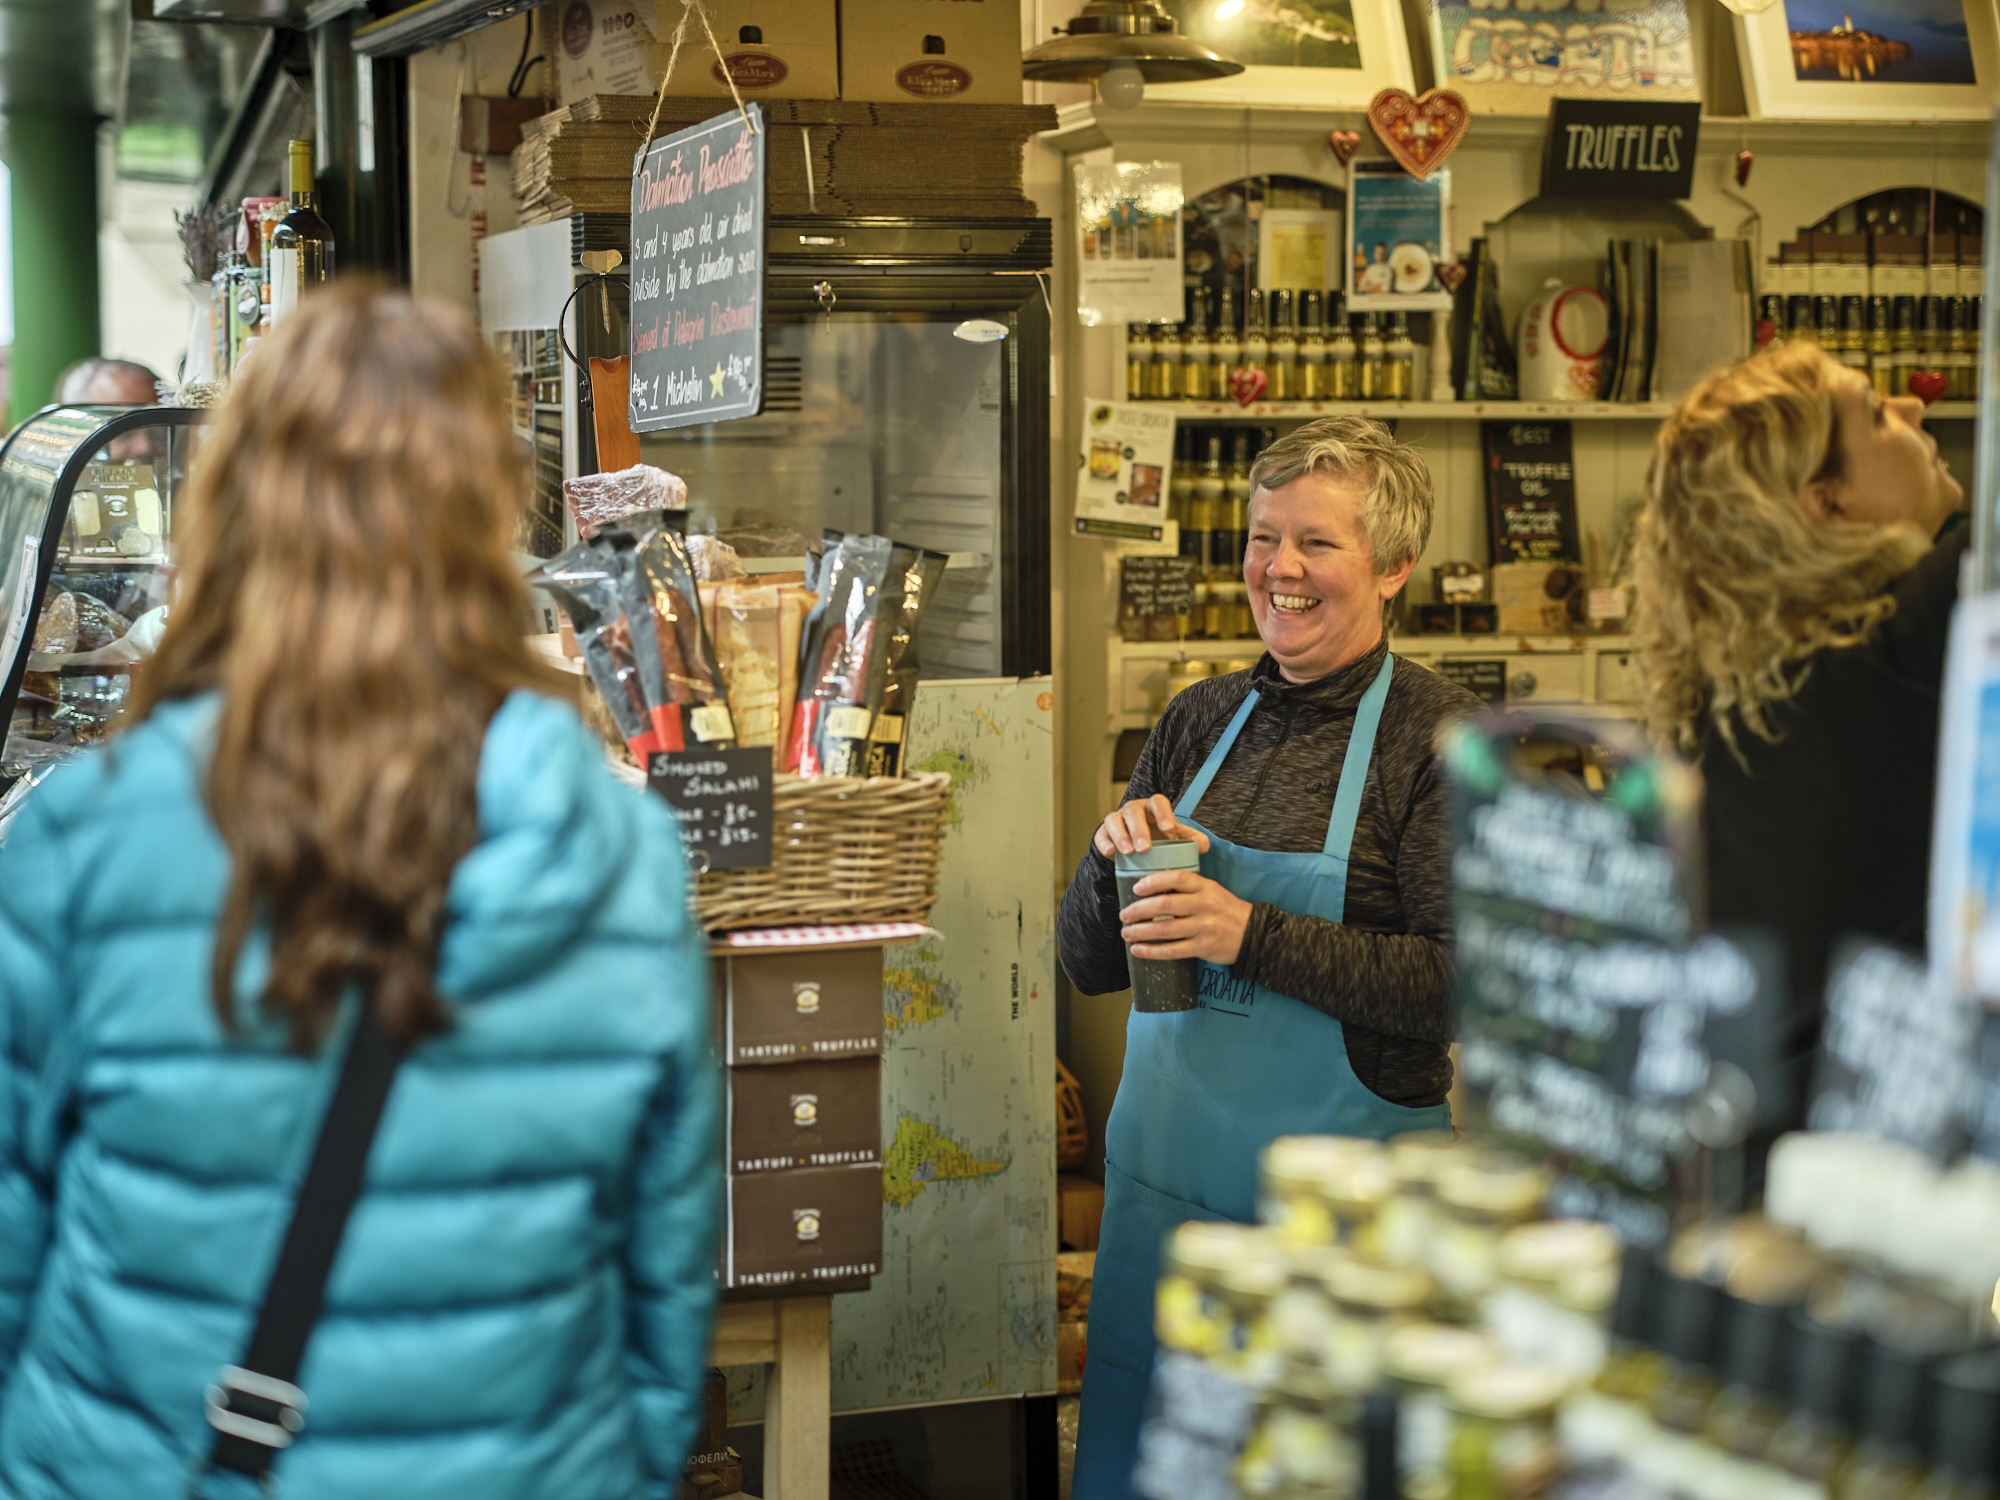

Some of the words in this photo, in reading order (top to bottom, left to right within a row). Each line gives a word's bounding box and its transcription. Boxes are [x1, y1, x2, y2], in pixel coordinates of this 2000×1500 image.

[1565, 124, 1684, 172] TRUFFLES
[635, 238, 641, 260] 3
[643, 224, 659, 259] and
[662, 231, 668, 254] 4
[672, 226, 695, 259] years
[717, 214, 730, 240] air
[732, 196, 754, 236] dried
[633, 268, 661, 302] outside
[666, 263, 677, 301] by
[679, 257, 693, 290] the
[738, 249, 756, 275] sea
[632, 315, 659, 355] Served
[662, 310, 671, 348] at
[650, 375, 659, 410] 1
[665, 366, 702, 406] Michelin
[1502, 462, 1573, 480] TRUFFLE
[651, 753, 728, 777] SMOKED
[682, 775, 759, 797] SALAMI
[1198, 968, 1255, 1006] CROATIA
[1011, 1001, 1019, 1021] THE
[739, 1043, 796, 1058] TARTUFI
[813, 1037, 877, 1052] TRUFFLES
[737, 1157, 794, 1171] TARTUFI
[811, 1150, 874, 1165] TRUFFLES
[740, 1271, 796, 1286] TARTUFI
[813, 1263, 877, 1279] TRUFFLES
[686, 1452, 728, 1466] ЮФЕЛИ
